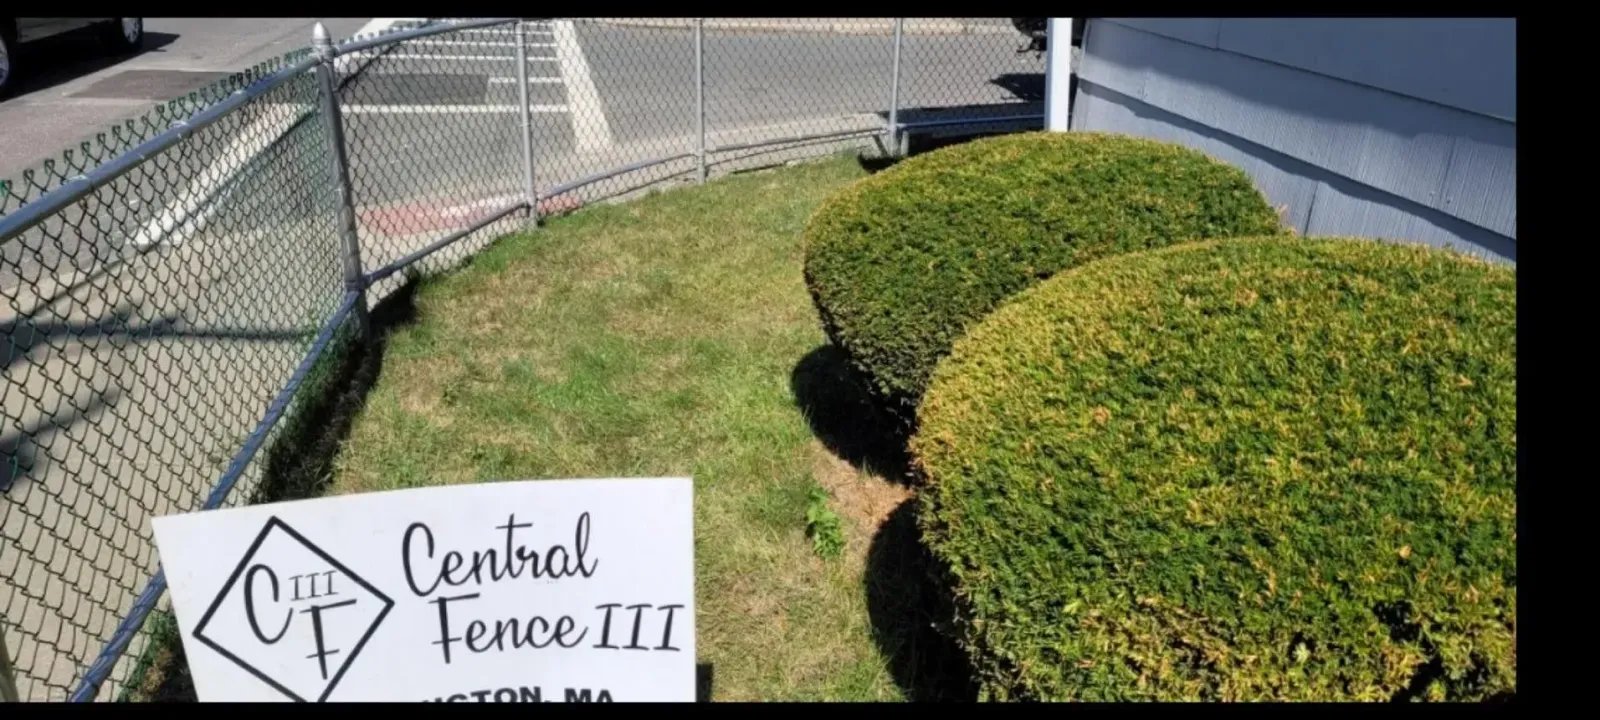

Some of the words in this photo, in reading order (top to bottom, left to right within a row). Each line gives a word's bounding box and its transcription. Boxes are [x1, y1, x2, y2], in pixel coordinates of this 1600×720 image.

[402, 511, 598, 597] Central
[244, 563, 293, 645] C
[427, 593, 588, 664] Fence
[592, 603, 685, 651] III
[422, 686, 552, 703] TON
[564, 687, 614, 703] MA
